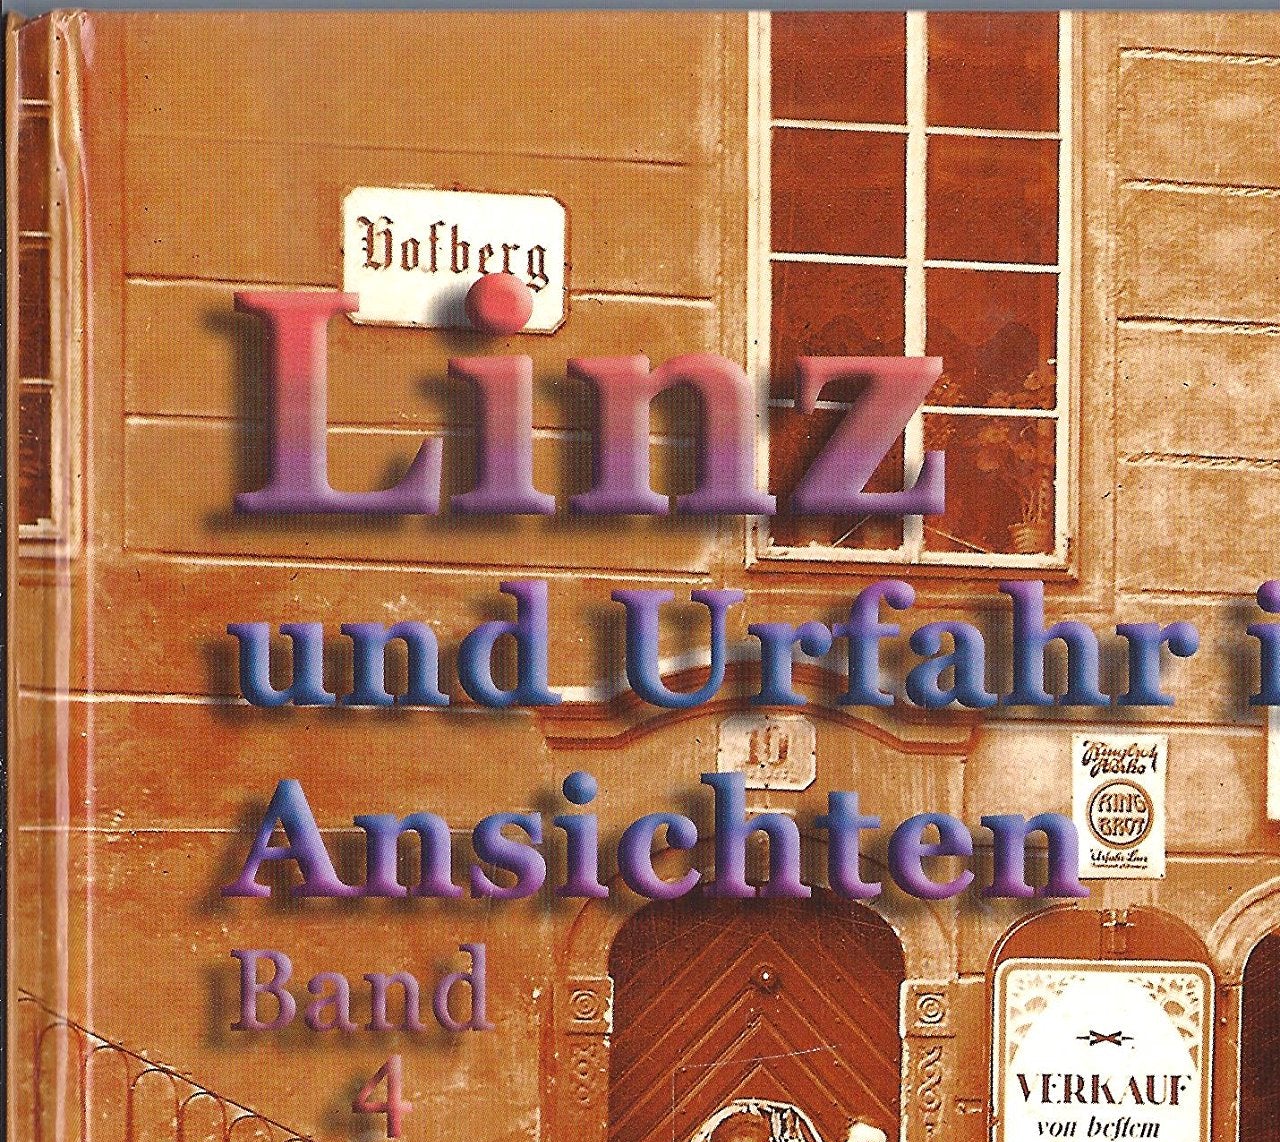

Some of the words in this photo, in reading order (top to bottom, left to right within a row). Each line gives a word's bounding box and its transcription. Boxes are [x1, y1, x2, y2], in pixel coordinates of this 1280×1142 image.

[1098, 793, 1147, 813] RING
[1016, 1073, 1192, 1106] VERKAUF
[1038, 1121, 1077, 1138] von
